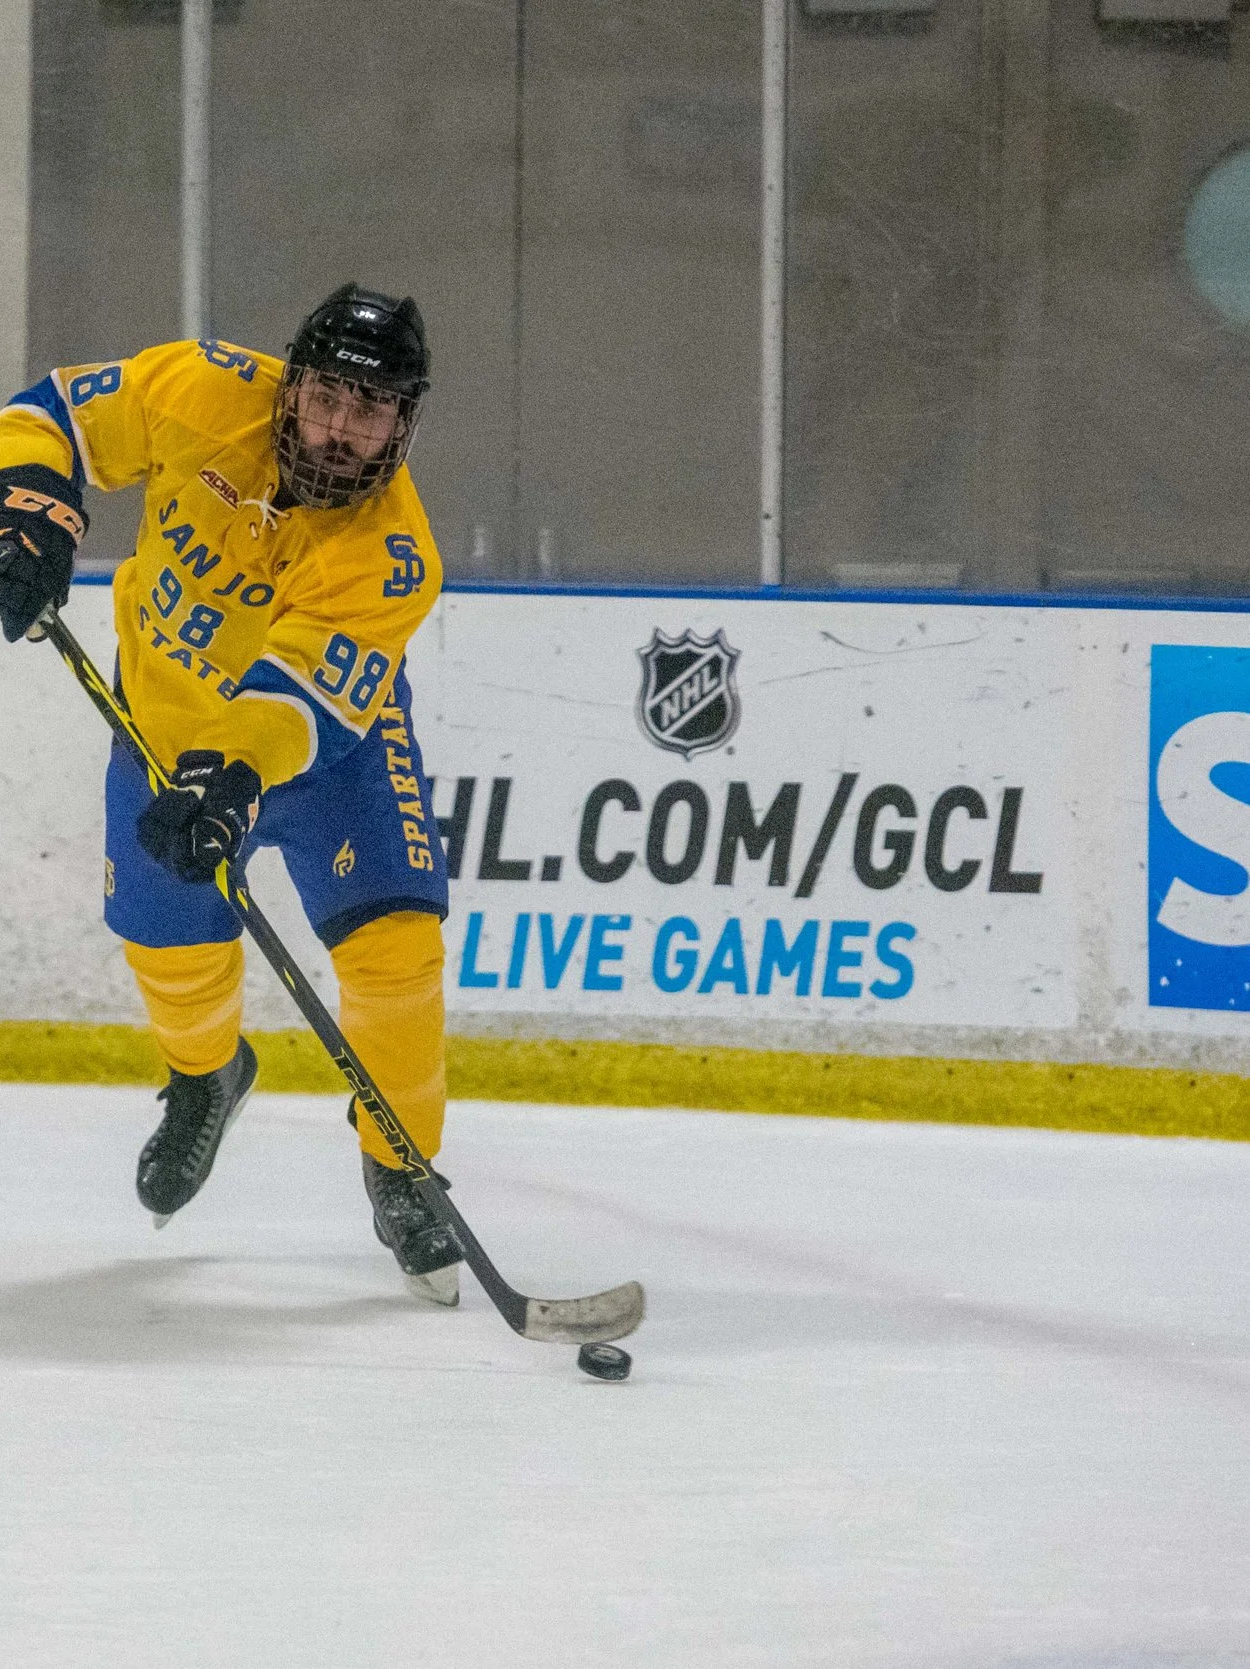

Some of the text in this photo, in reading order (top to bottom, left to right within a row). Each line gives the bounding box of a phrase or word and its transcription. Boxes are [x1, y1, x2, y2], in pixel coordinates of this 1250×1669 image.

[336, 349, 381, 368] CCM
[201, 470, 239, 507] ACHA
[159, 498, 222, 579] SAN
[151, 566, 225, 650] 98
[139, 604, 238, 702] STATE
[313, 631, 391, 712] 98
[660, 664, 721, 728] NHL
[180, 767, 214, 780] CCM
[381, 686, 434, 872] SPARTAN
[459, 911, 918, 1001] LIVE GAMES
[333, 1047, 430, 1182] CCM
